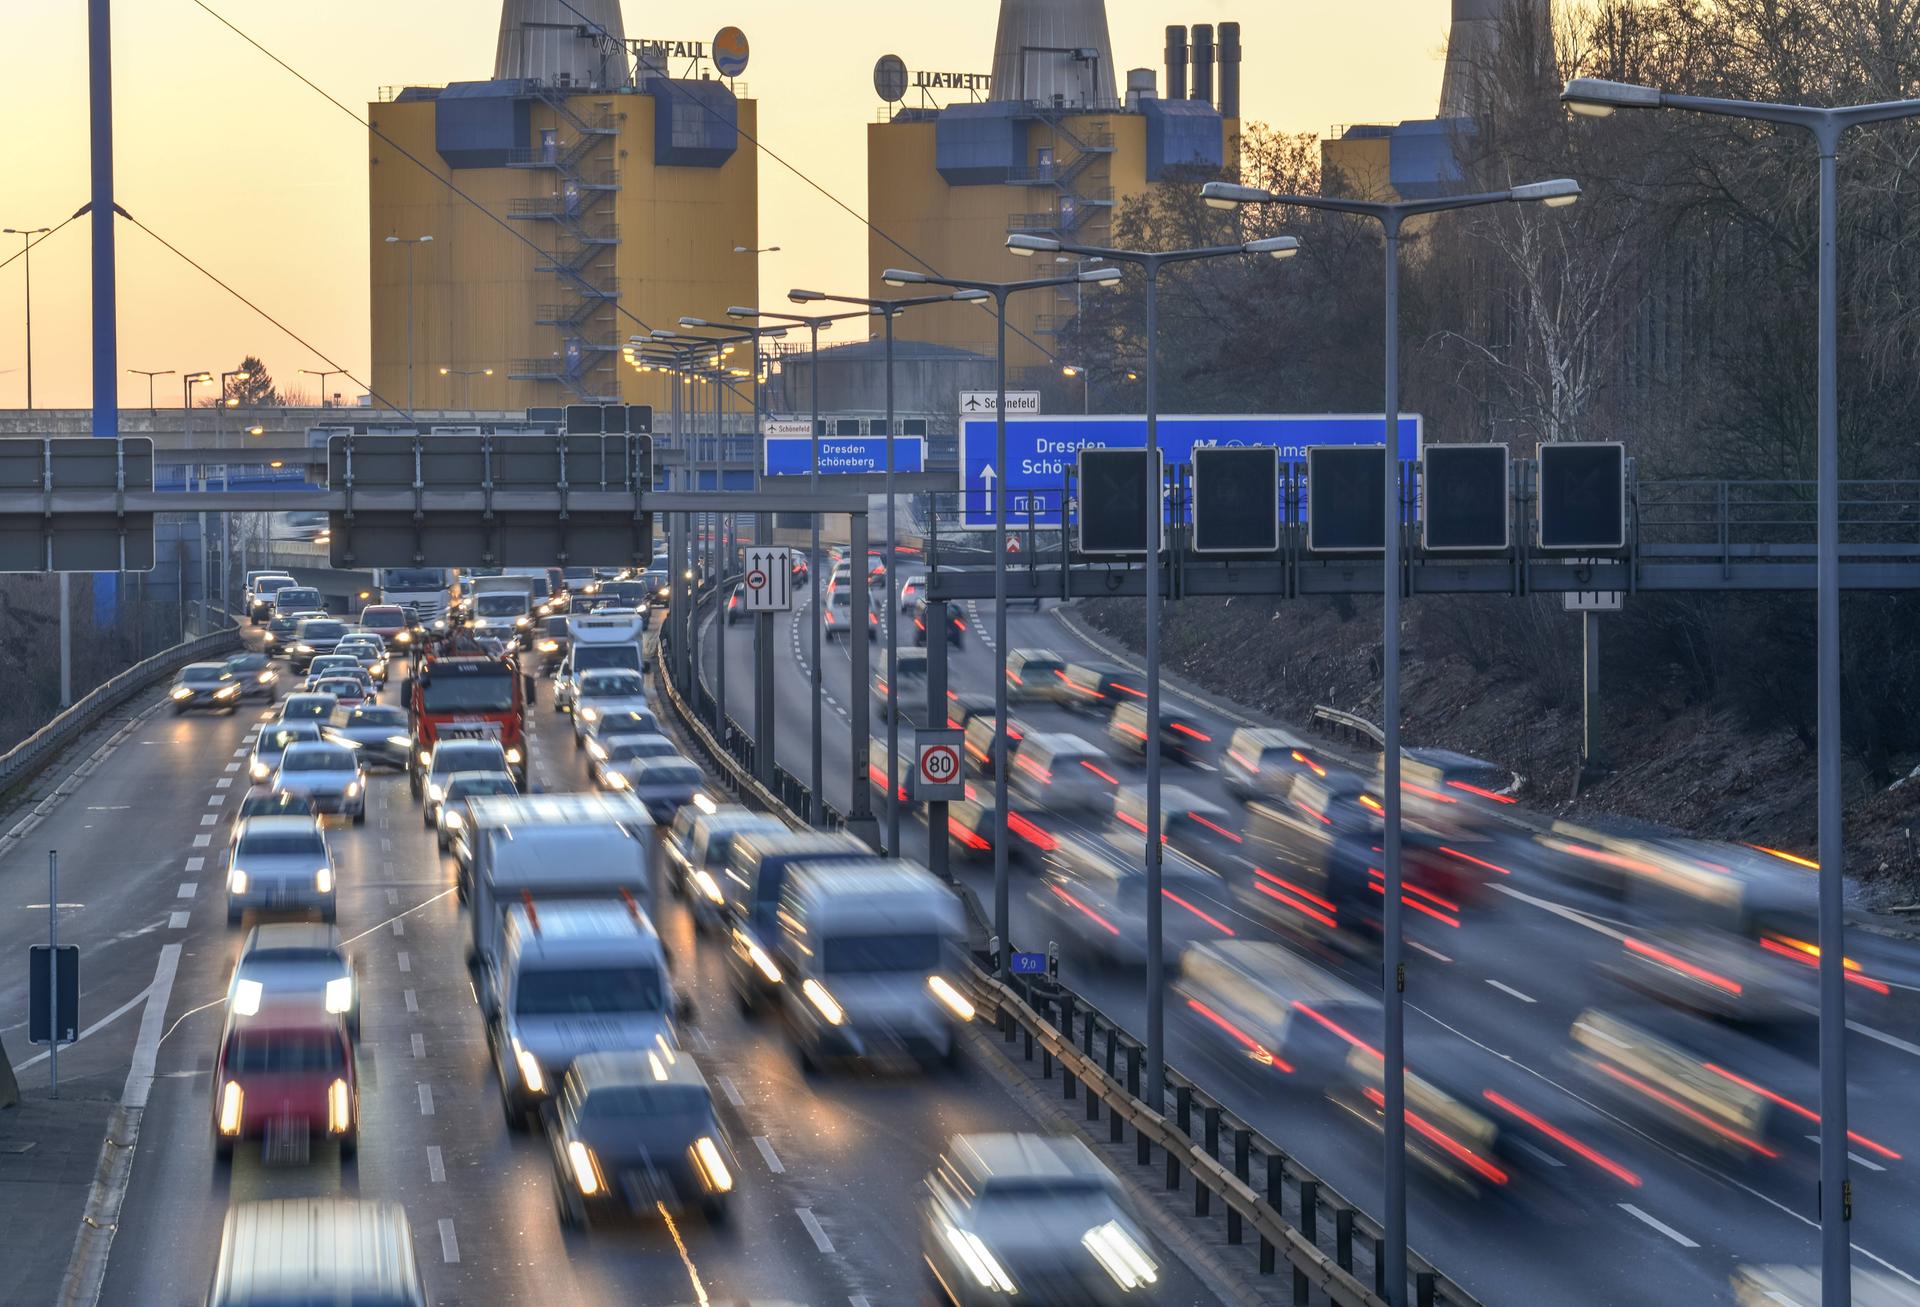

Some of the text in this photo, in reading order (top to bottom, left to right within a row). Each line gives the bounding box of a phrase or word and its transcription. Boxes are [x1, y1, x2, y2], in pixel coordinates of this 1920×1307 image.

[984, 397, 1036, 409] Scnefeld
[778, 424, 810, 433] Schönefeld
[823, 444, 865, 454] Dresden
[930, 756, 951, 773] 80
